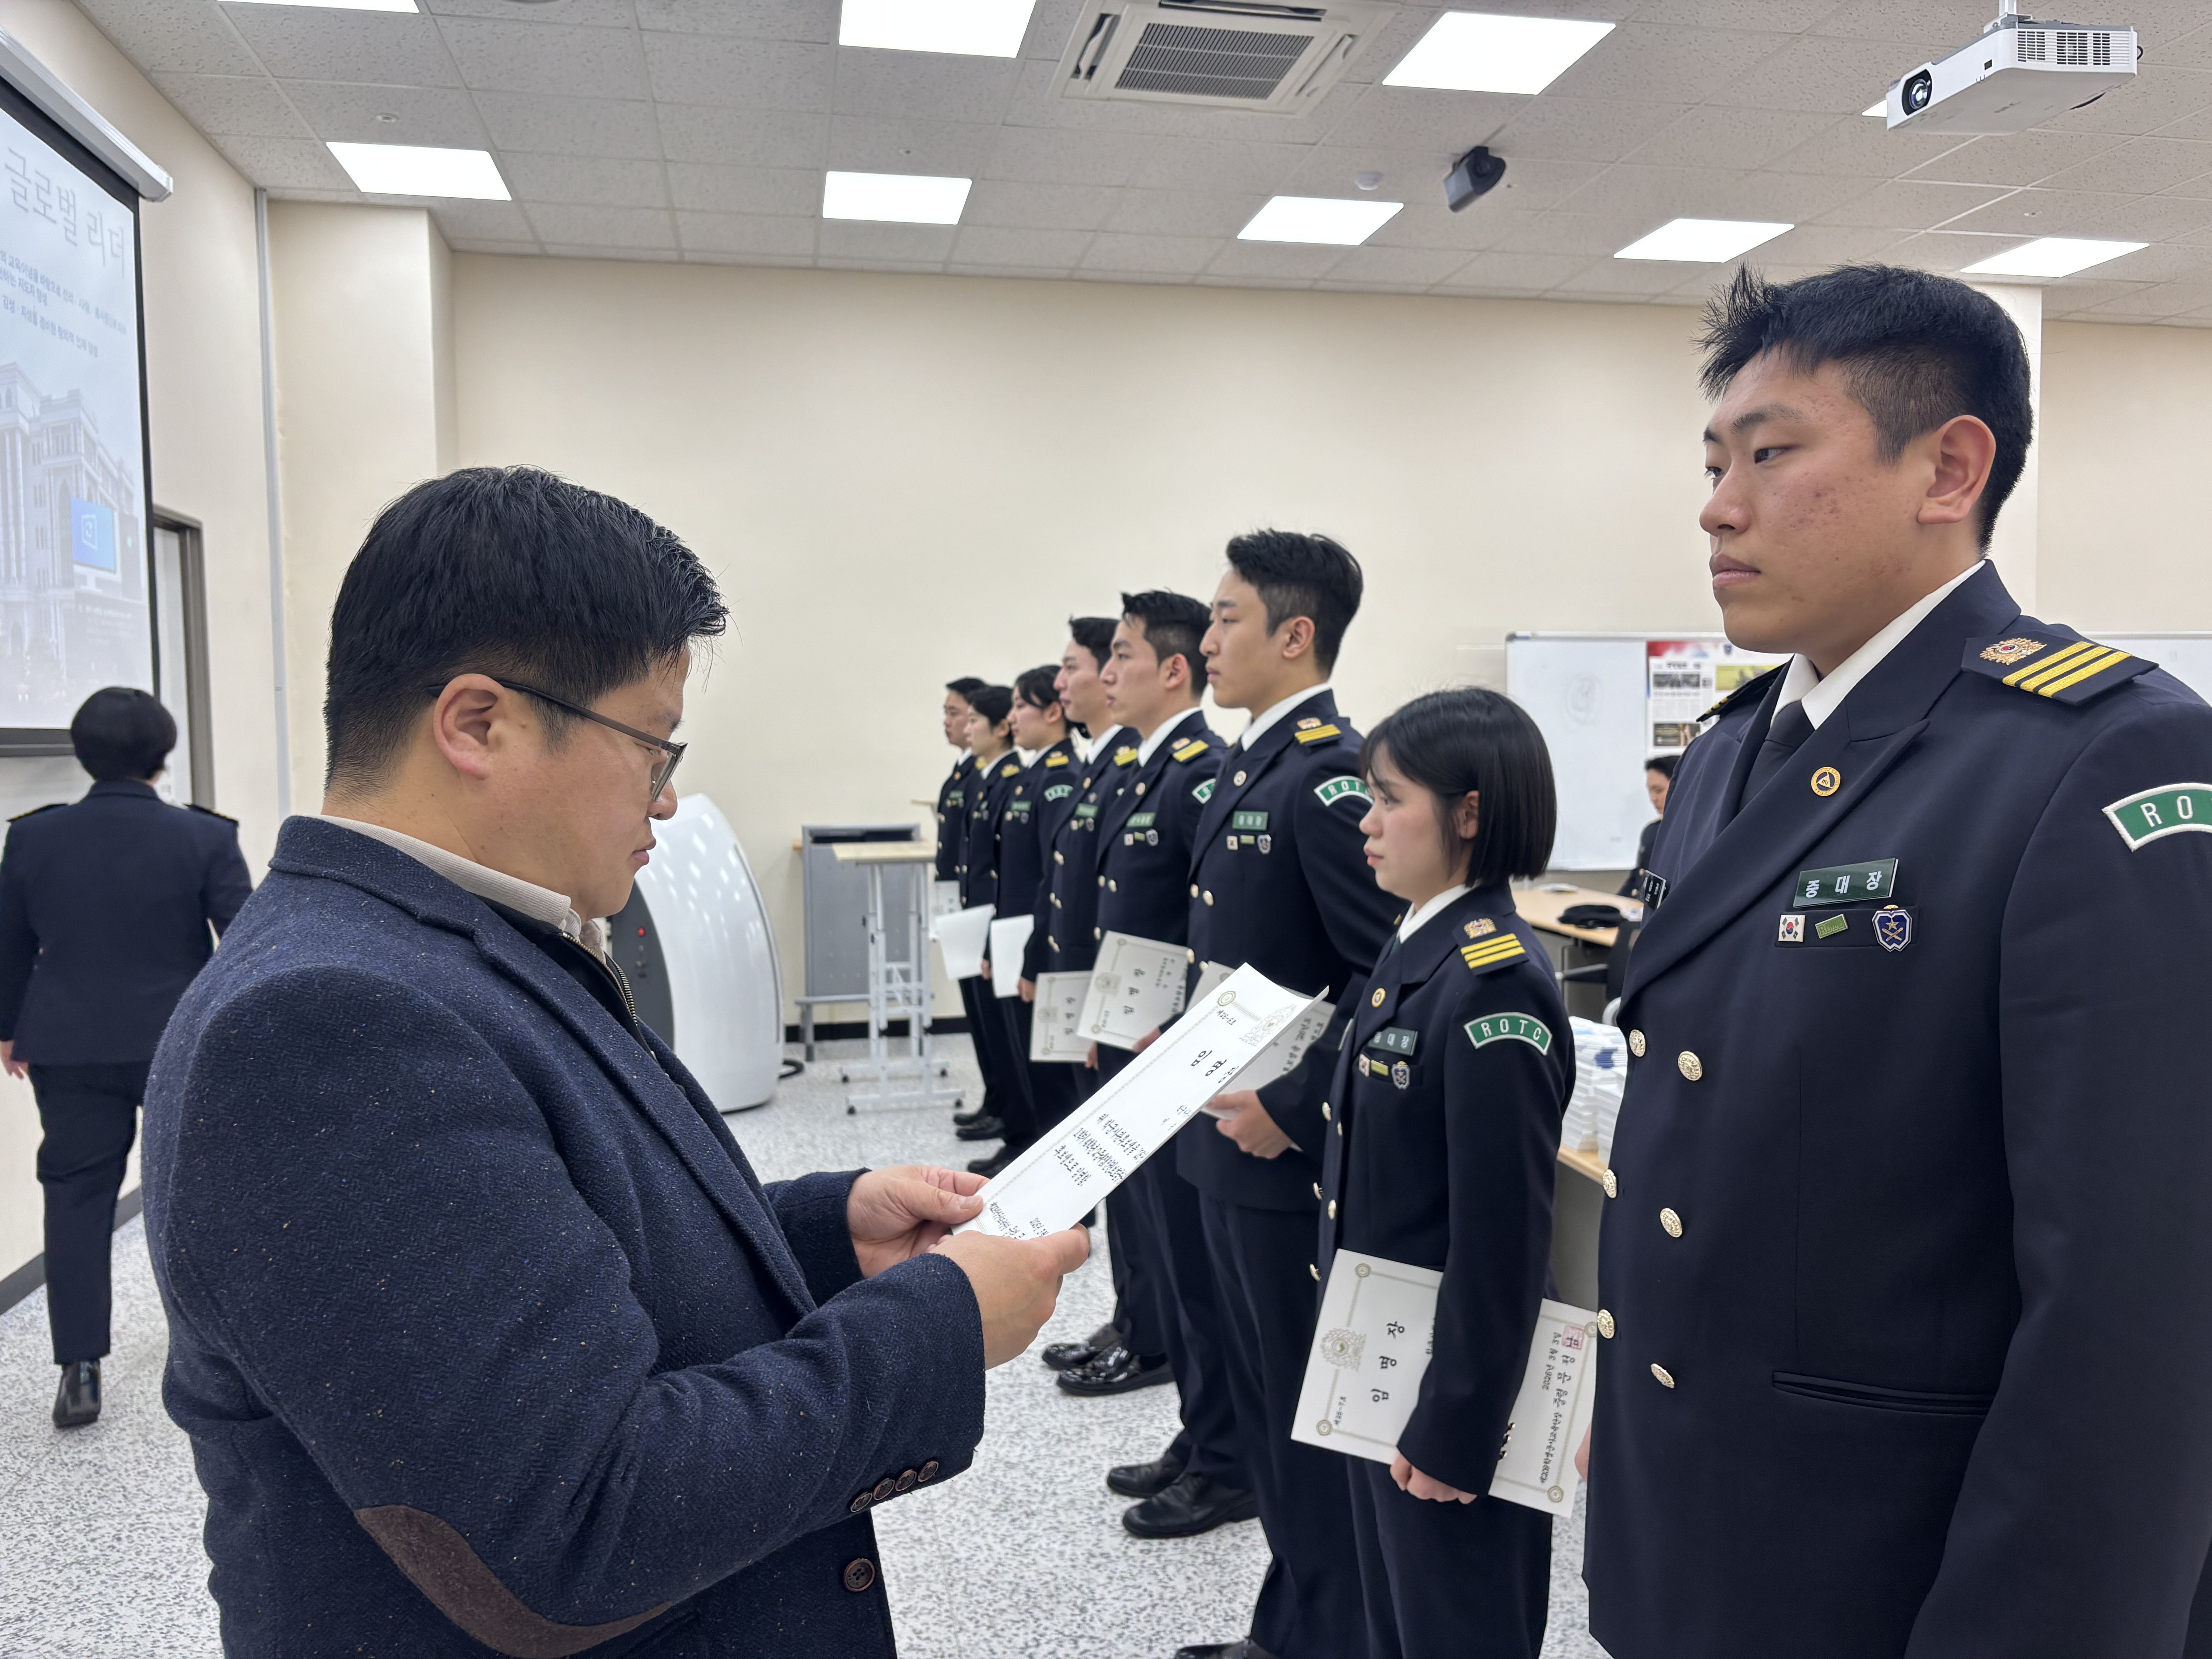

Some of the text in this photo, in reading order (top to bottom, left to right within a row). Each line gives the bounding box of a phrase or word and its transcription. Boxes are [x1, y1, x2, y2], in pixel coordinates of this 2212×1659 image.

[4, 147, 125, 279] 글로벌 리더
[1328, 780, 1369, 797] ROT
[2140, 795, 2212, 827] RO
[1805, 871, 1882, 898] 중대장
[1480, 1018, 1541, 1041] ROTC
[1190, 1049, 1240, 1084] 임명장
[1370, 1321, 1406, 1403] 임명장
[1541, 1364, 1554, 1391] 2026년
